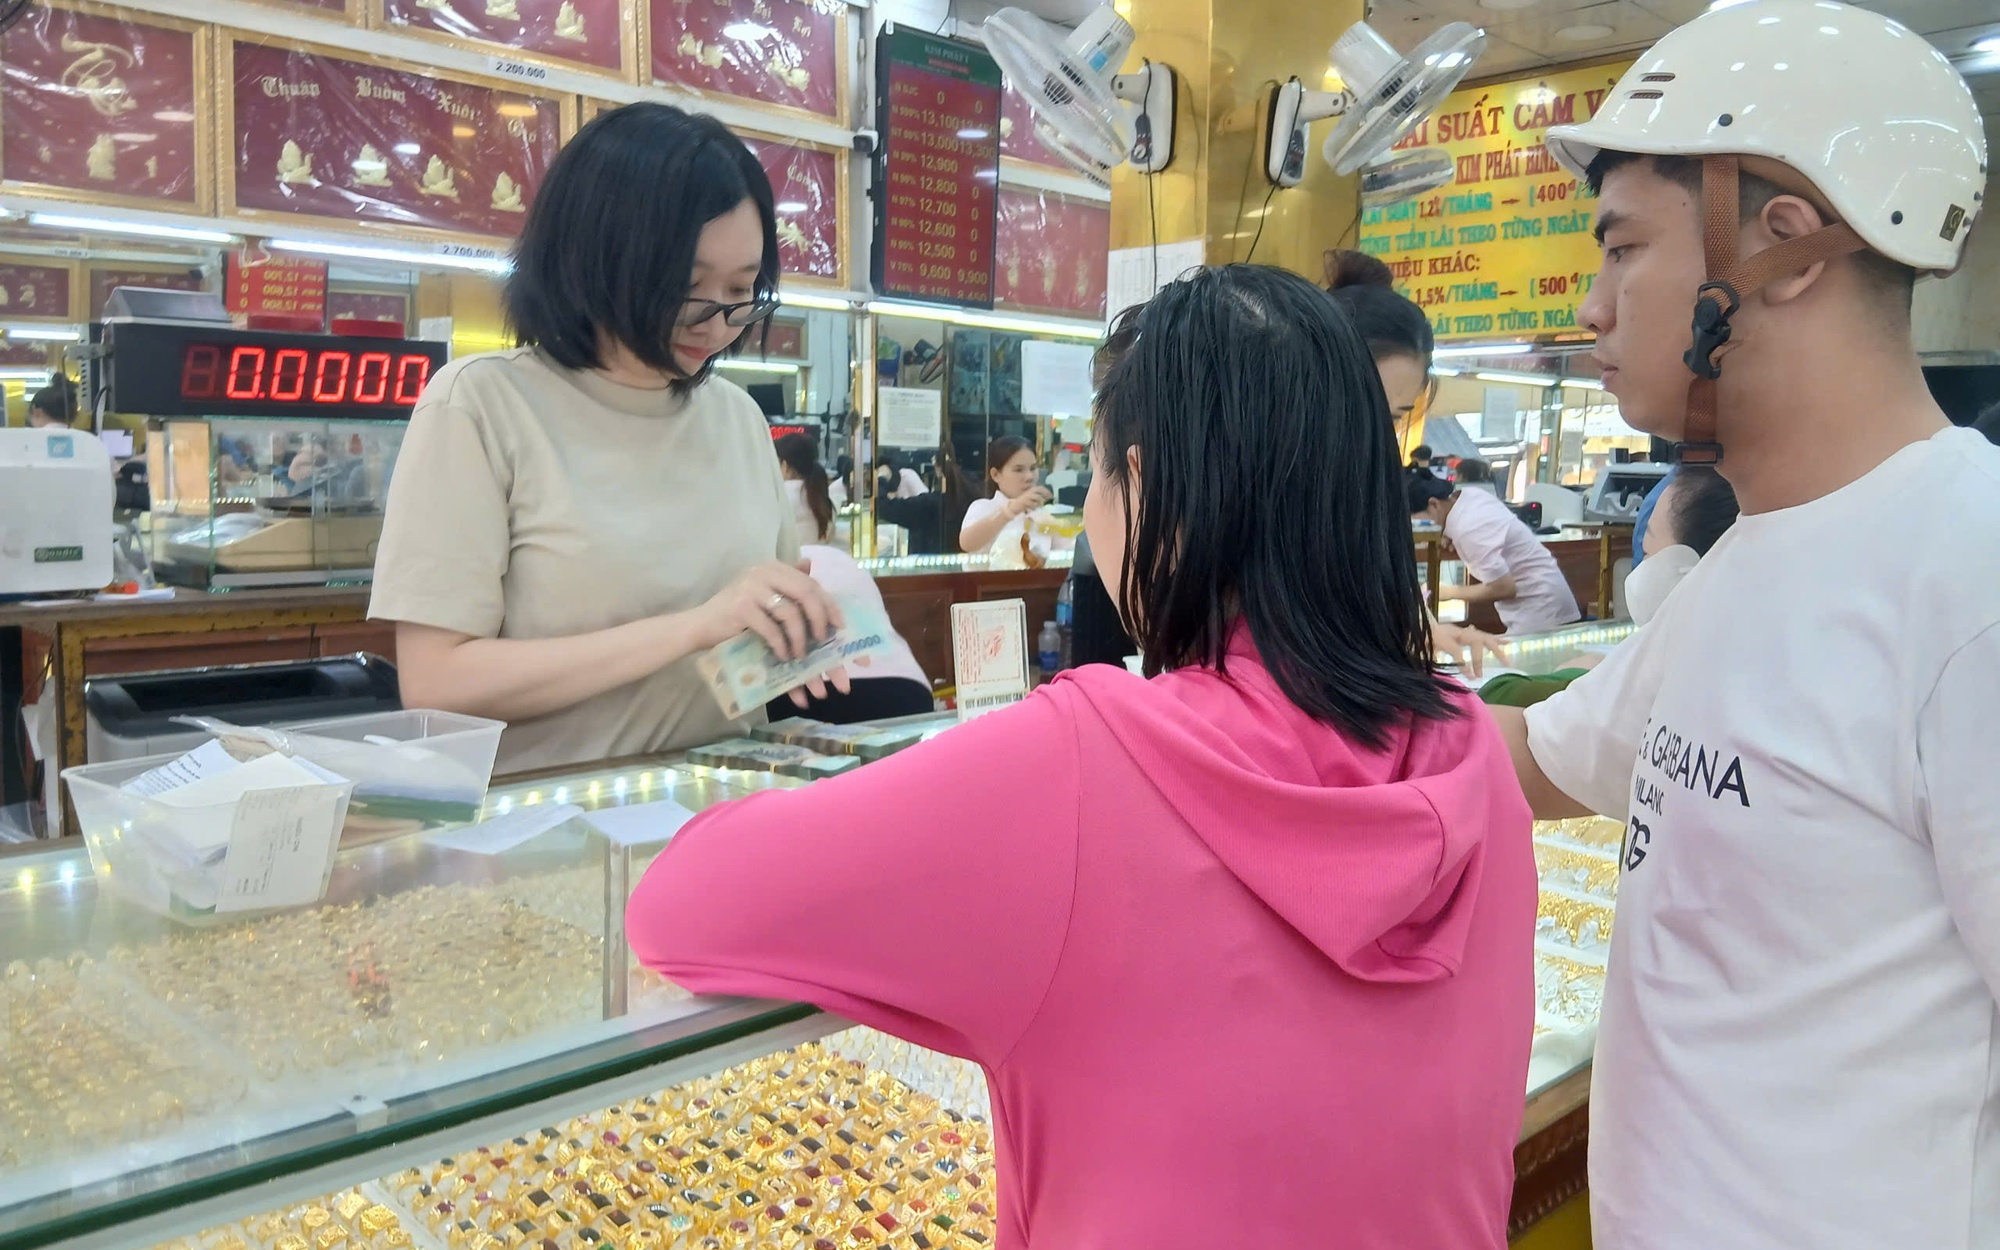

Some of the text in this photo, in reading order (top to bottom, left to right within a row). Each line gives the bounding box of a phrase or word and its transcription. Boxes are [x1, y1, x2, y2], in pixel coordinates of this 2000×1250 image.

[495, 61, 545, 79] 2.200.000
[936, 90, 945, 105] 0
[974, 100, 983, 114] 0
[1437, 94, 1504, 142] SUẤT
[1513, 81, 1576, 131] CẦM
[1455, 154, 1482, 185] KIM
[1485, 140, 1520, 180] PHÁT
[972, 186, 980, 199] 0
[920, 197, 957, 216] 12,700
[971, 207, 979, 220] 0
[970, 228, 978, 242] 0
[1395, 223, 1426, 251] TIỀN
[1458, 224, 1497, 243] THEO
[1501, 215, 1542, 241] TỪNG
[1546, 208, 1591, 236] NGÀY
[443, 245, 495, 258] 2.700.000
[969, 249, 977, 263] 0
[1428, 251, 1481, 276] KHÁC:
[1454, 313, 1493, 334] THEO
[1497, 306, 1538, 331] TỪNG
[1543, 304, 1577, 327] NGÀ
[225, 346, 430, 404] 0.0000
